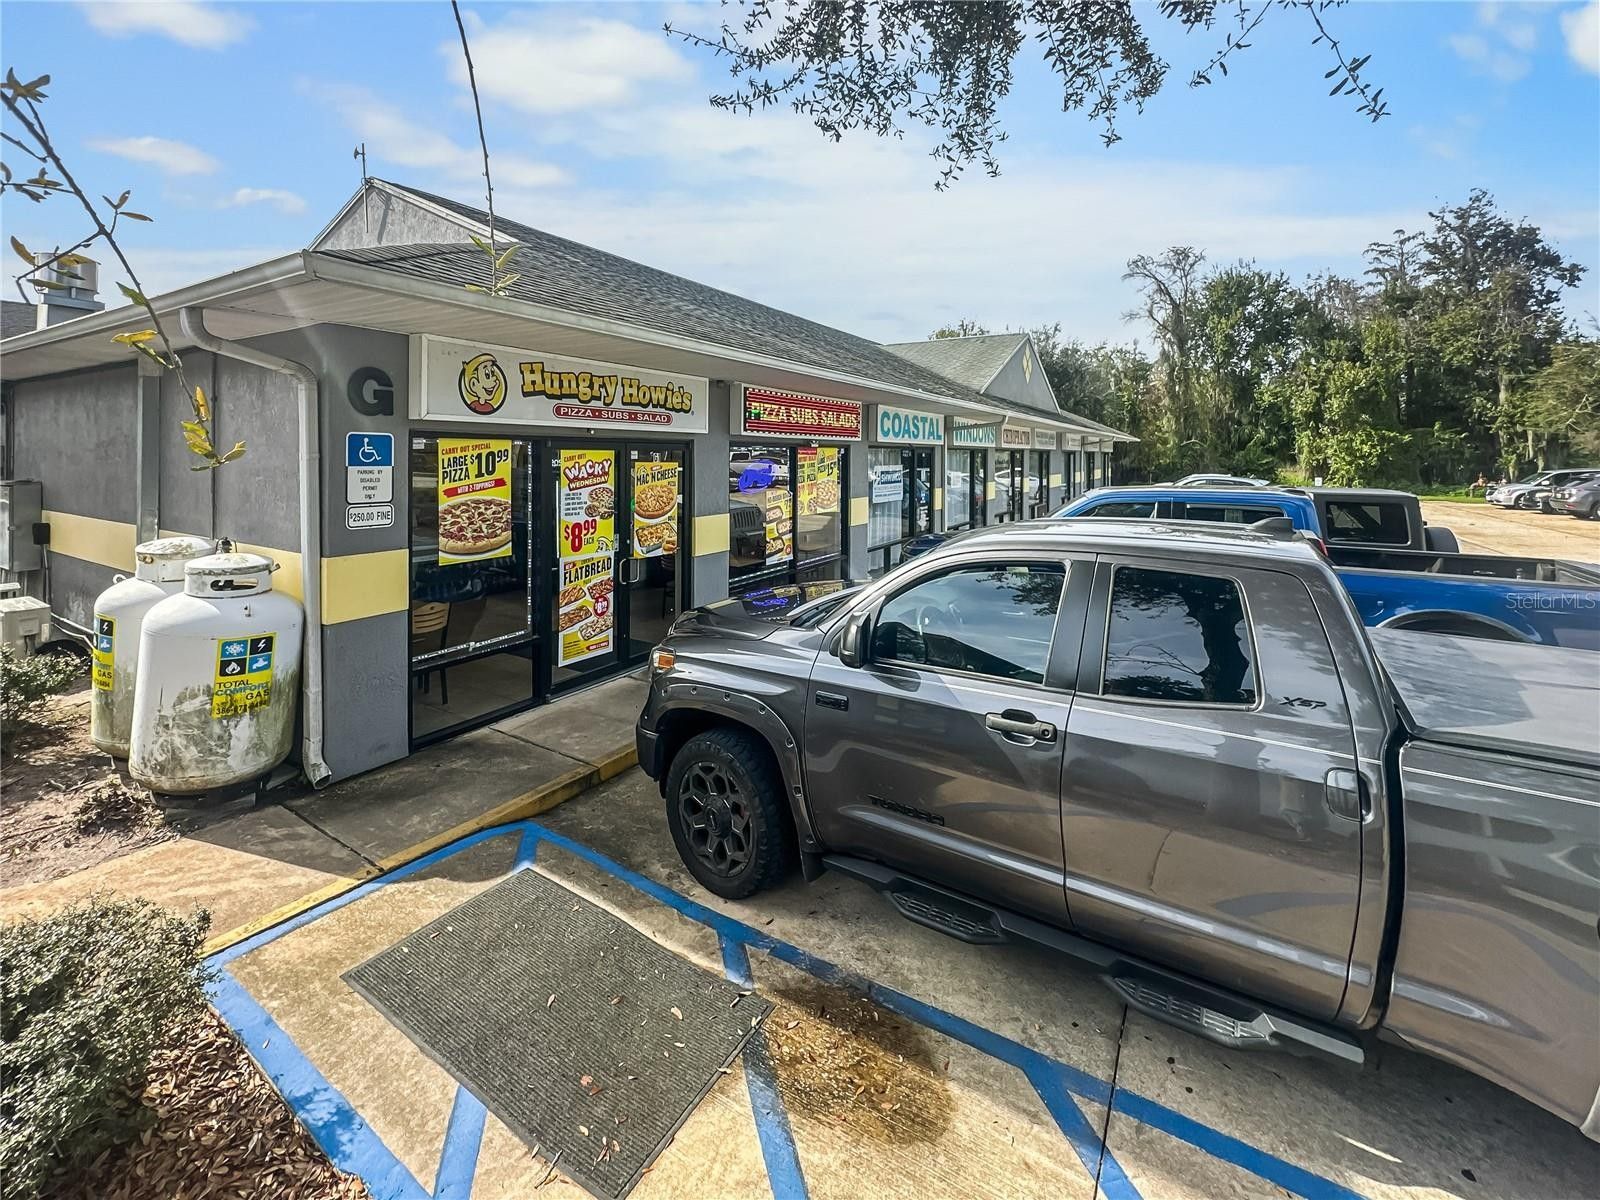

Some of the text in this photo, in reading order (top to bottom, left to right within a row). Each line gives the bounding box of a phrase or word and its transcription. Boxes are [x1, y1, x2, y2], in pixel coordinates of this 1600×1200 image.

[347, 366, 394, 417] G
[519, 362, 692, 414] Hungry Howie's
[560, 407, 668, 423] PIZZA SUBS SALAD
[751, 402, 858, 428] PIZZA SUBS SALADS
[880, 410, 942, 441] COASTAL
[954, 418, 995, 444] WINDOWS
[441, 442, 492, 456] CARRY OUT SPECIAL
[441, 454, 469, 470] LARGE
[564, 459, 611, 480] WACKY
[441, 467, 471, 485] PIZZA
[569, 475, 609, 489] WEDNESDAY
[636, 473, 650, 486] MAC
[656, 467, 678, 482] CHEESE
[349, 510, 391, 522] $250.00 FINE
[584, 537, 595, 546] EACH
[563, 557, 612, 586] FLATBREAD
[97, 669, 112, 679] GAS
[216, 679, 252, 689] TOTAL
[245, 688, 270, 700] GAS
